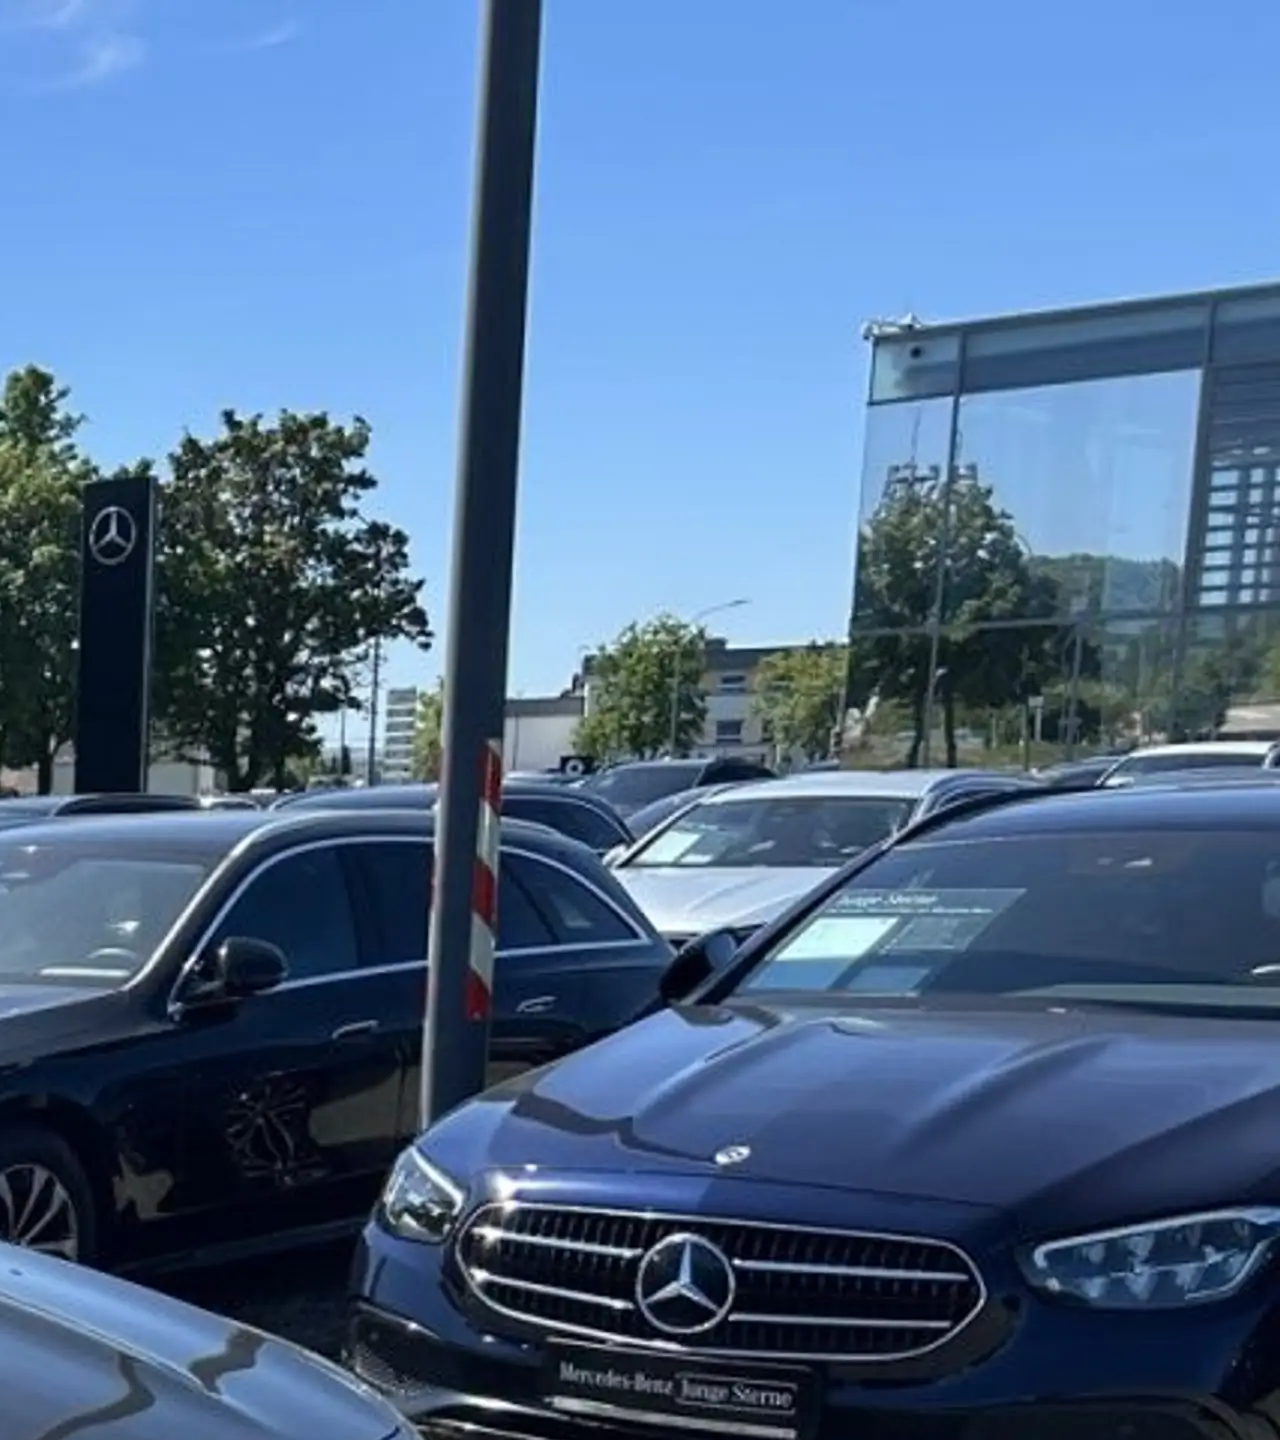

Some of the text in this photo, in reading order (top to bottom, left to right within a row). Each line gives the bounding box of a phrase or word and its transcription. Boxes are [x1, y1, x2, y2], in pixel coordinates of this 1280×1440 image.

[559, 1361, 792, 1407] Mercedes-Benz Junge Sterne
